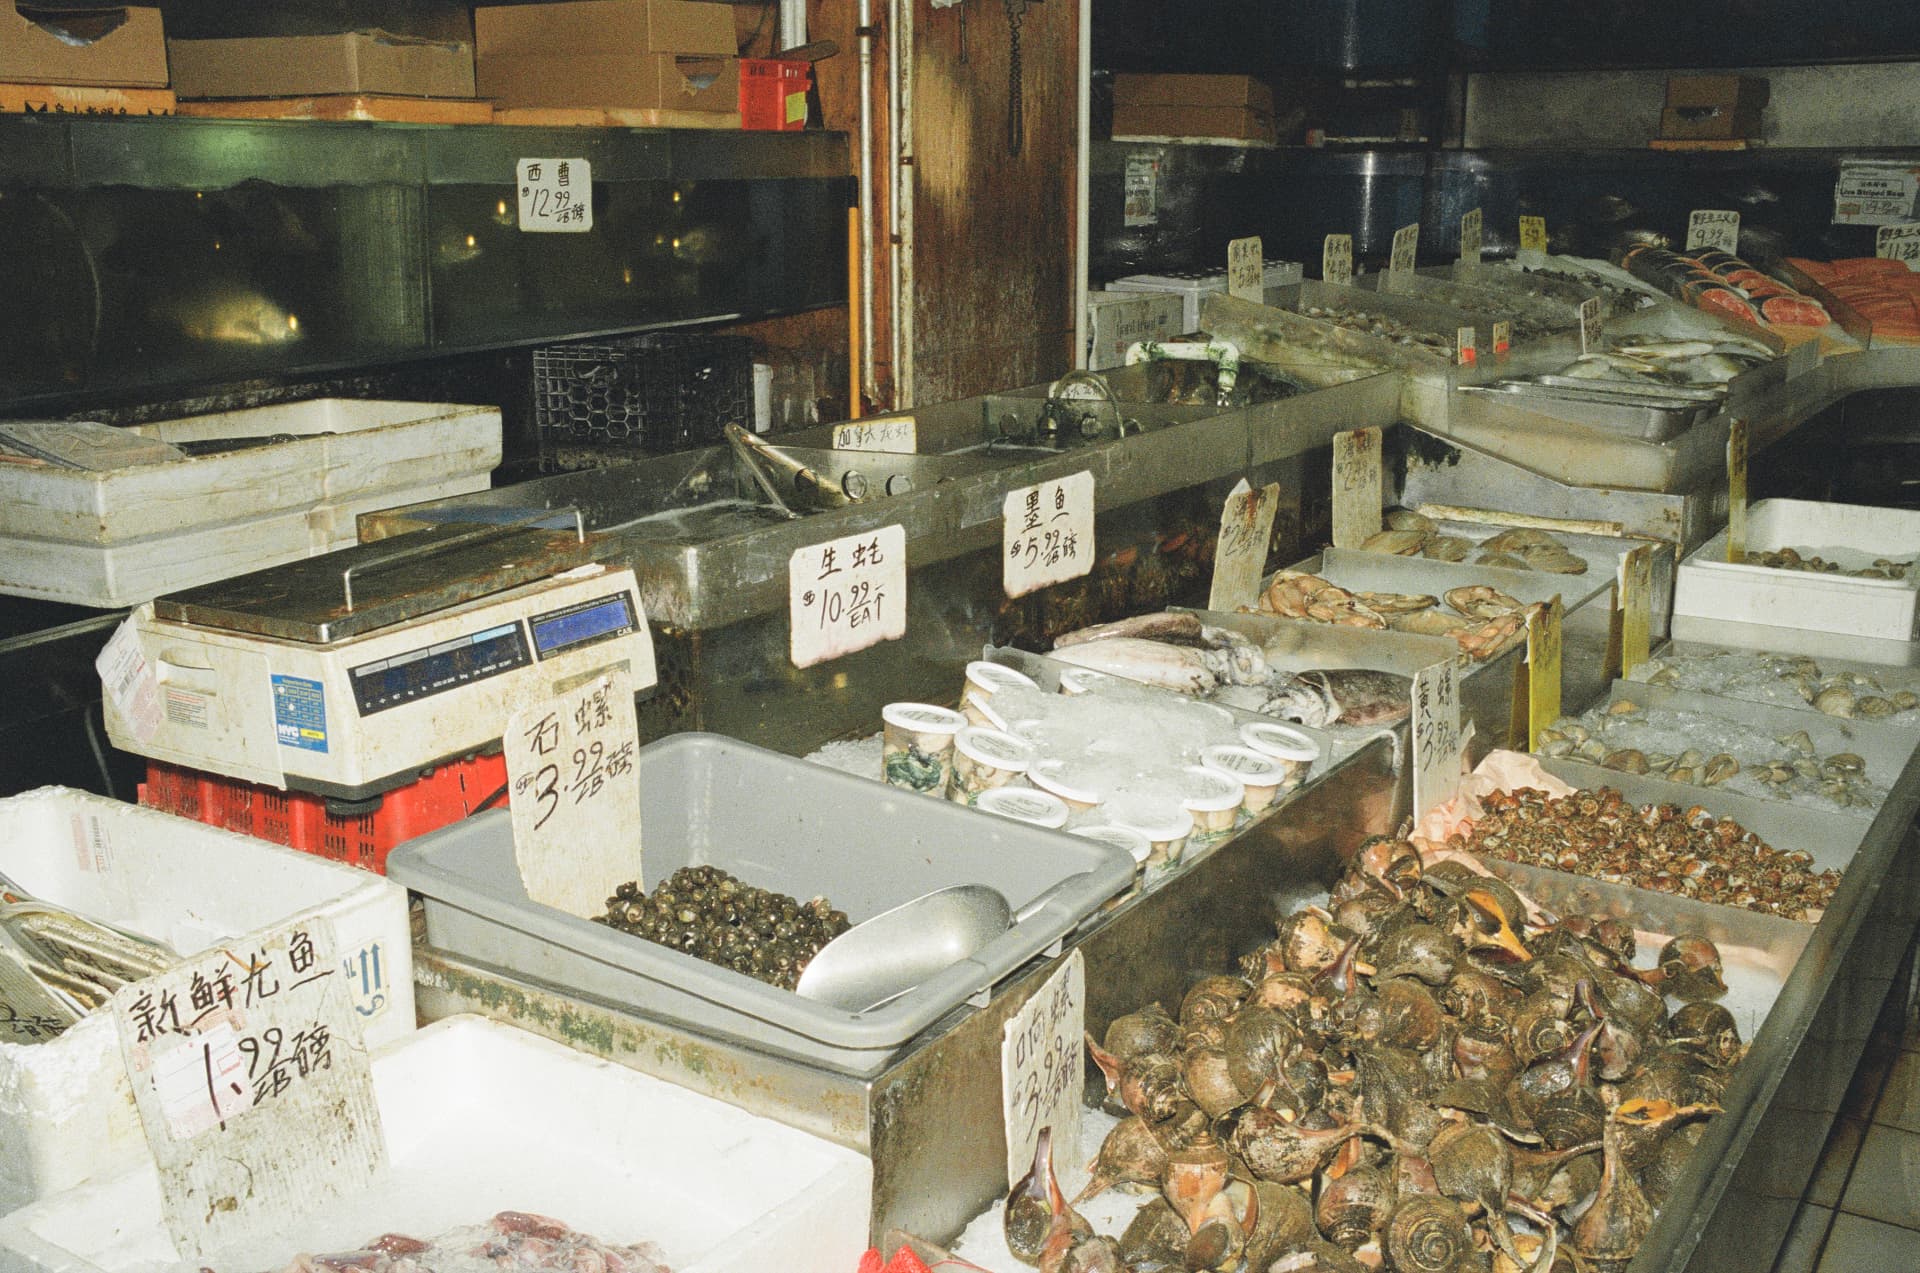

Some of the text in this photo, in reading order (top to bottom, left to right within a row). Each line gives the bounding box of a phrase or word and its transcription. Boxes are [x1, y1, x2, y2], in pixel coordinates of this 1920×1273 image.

[1022, 485, 1070, 533] 墨鱼
[818, 537, 883, 580] 生蚝
[850, 606, 871, 628] EA
[617, 626, 633, 637] CAS
[278, 723, 300, 737] NYC
